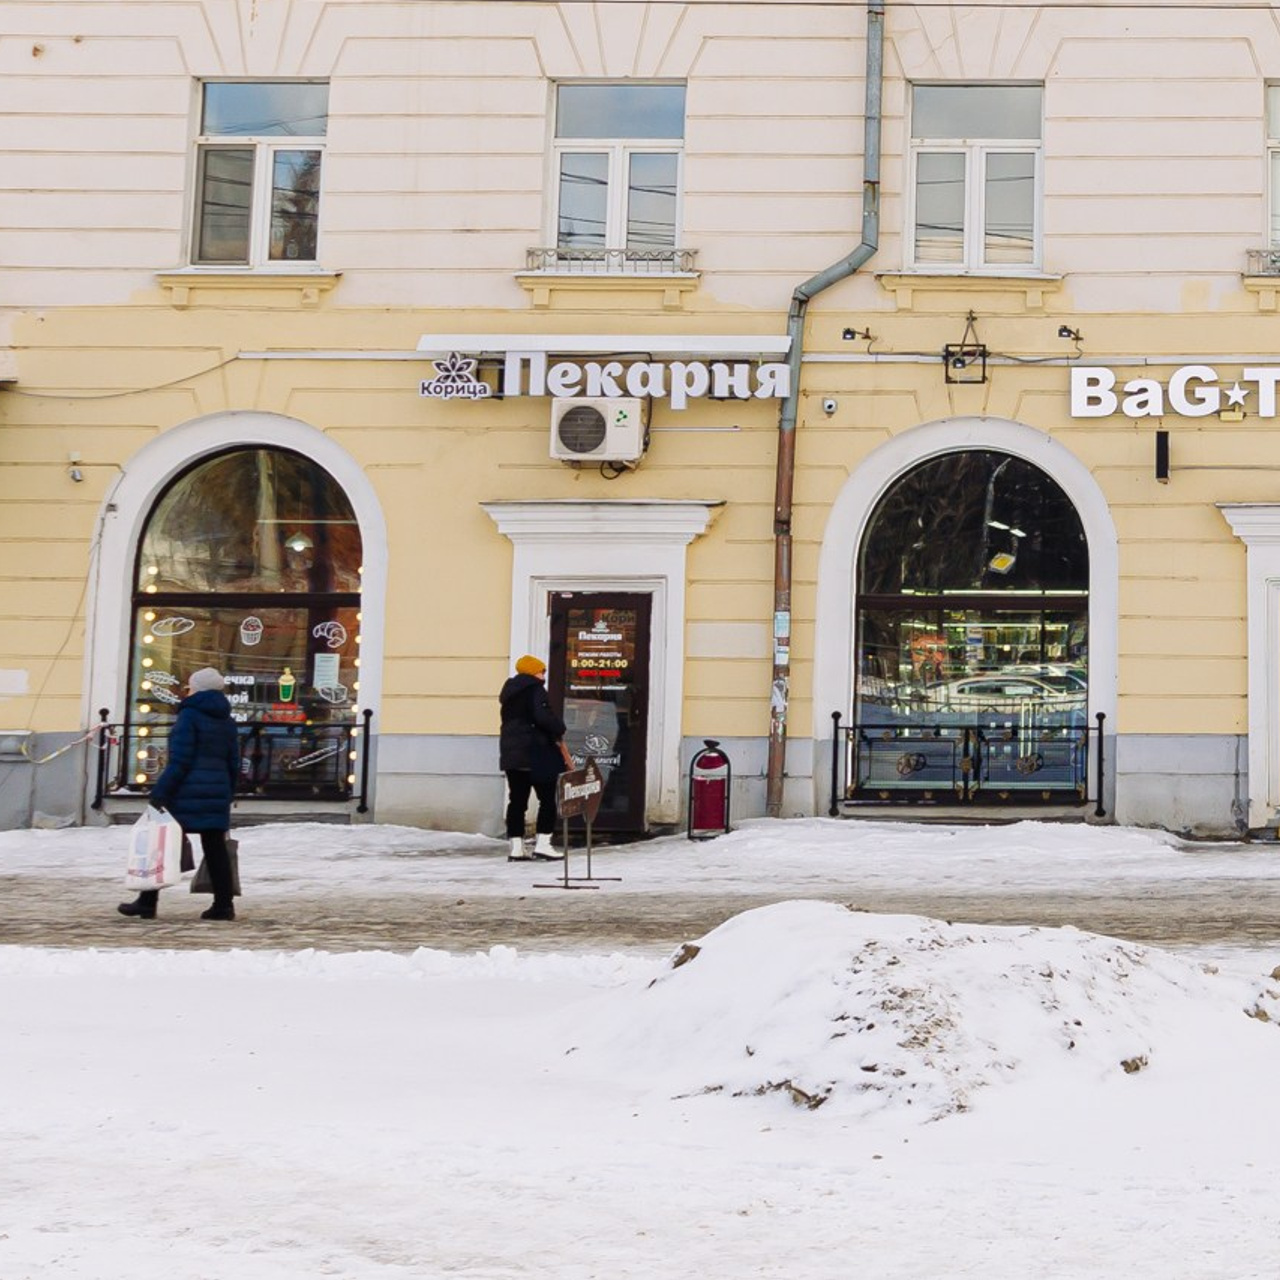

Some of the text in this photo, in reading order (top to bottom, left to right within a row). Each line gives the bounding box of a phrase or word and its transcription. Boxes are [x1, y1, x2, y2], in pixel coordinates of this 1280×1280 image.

[503, 351, 791, 410] Пекарня
[420, 381, 489, 398] Корица
[1070, 365, 1221, 418] BaG
[578, 631, 622, 642] Пекарня
[223, 675, 255, 685] ечка
